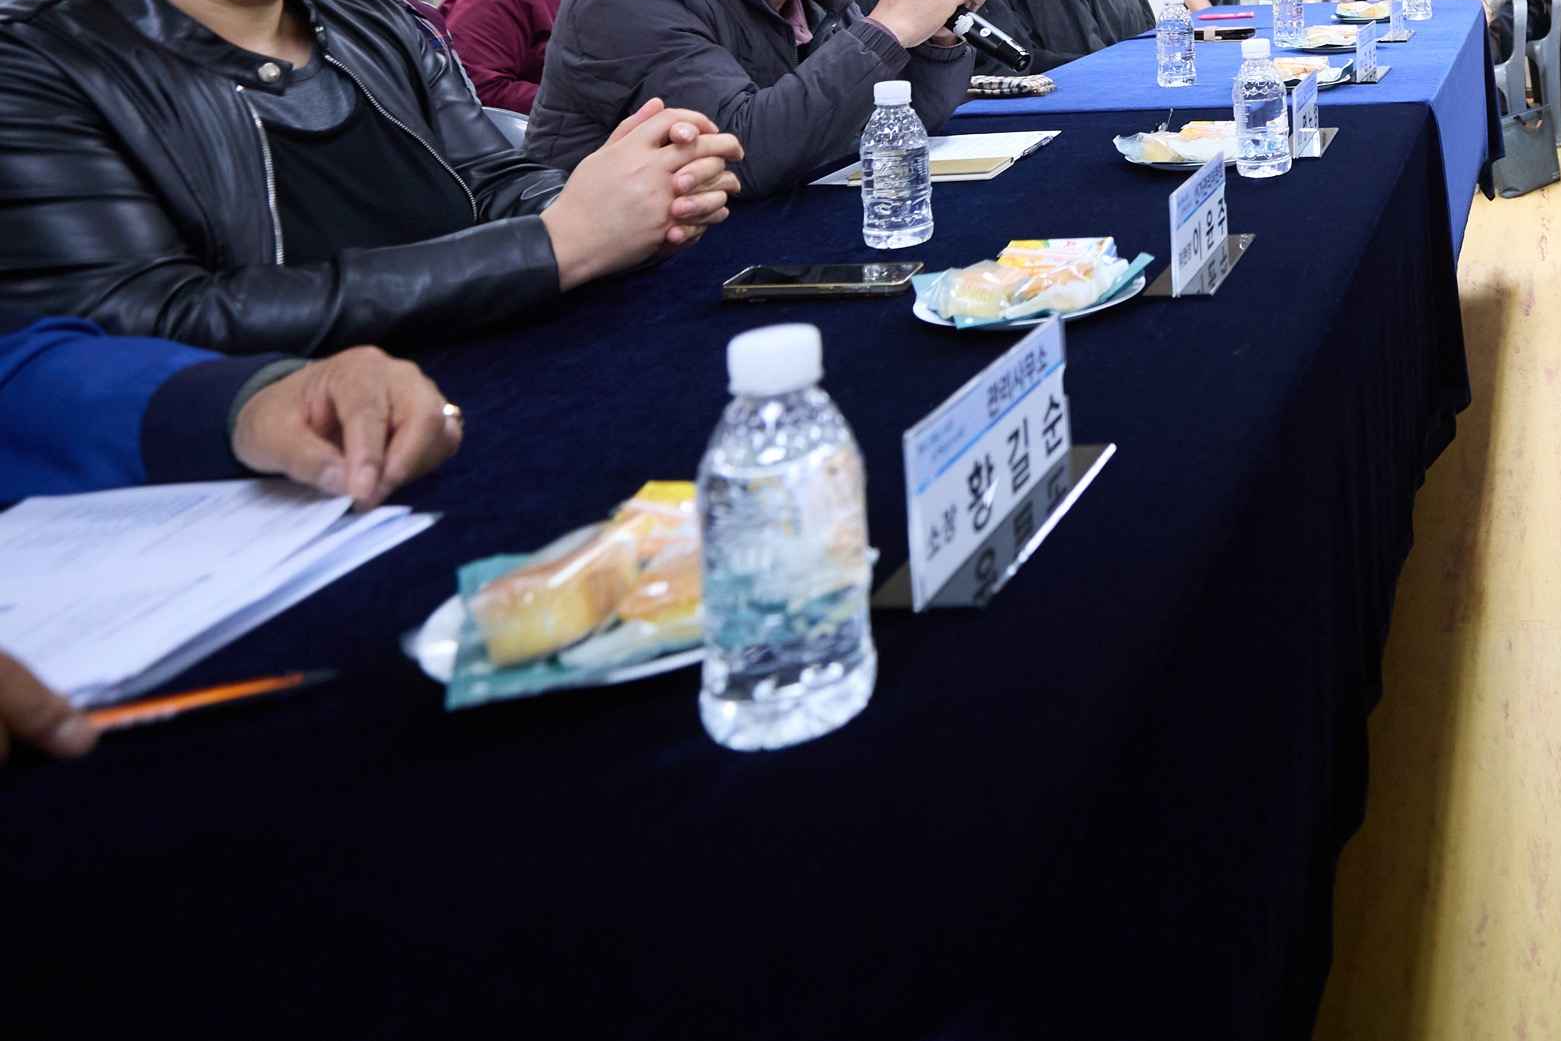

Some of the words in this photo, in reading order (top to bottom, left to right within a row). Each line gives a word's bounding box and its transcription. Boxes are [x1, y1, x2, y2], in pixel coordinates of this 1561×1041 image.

[986, 343, 1049, 419] 관리사무소
[926, 503, 957, 562] 소장
[967, 393, 1063, 533] 황길순
